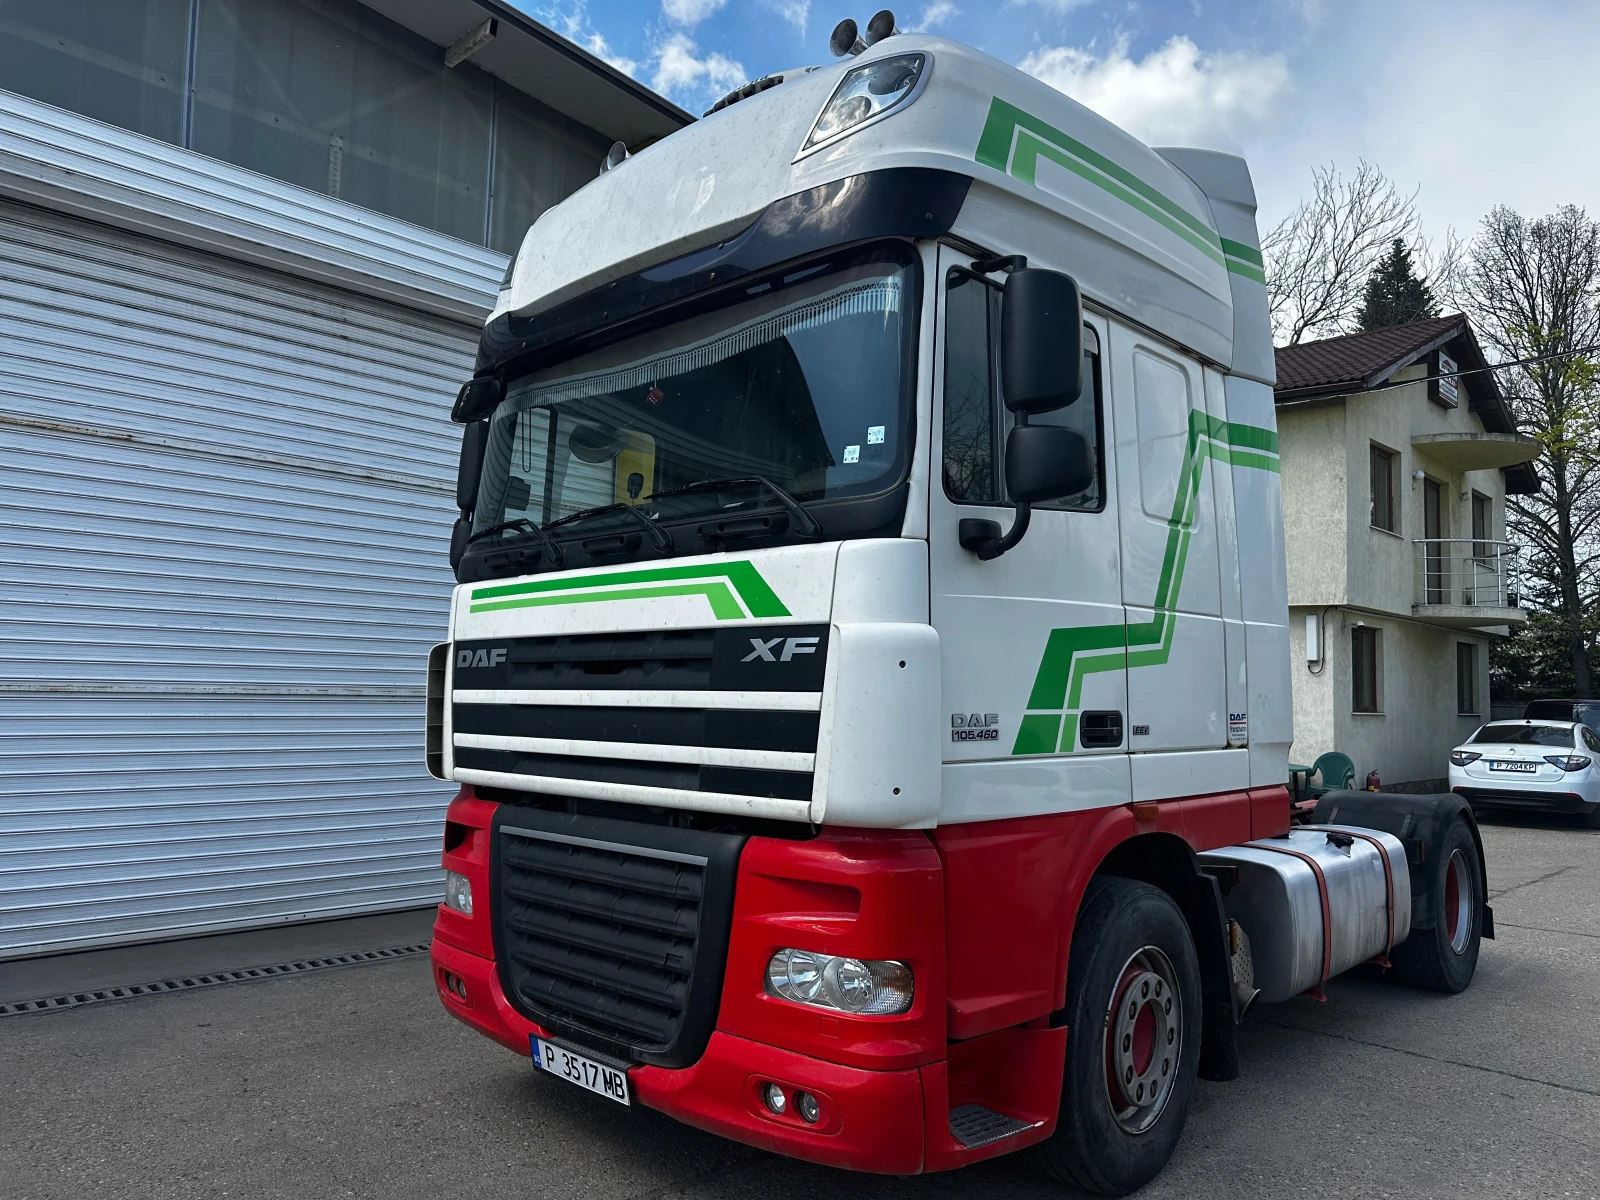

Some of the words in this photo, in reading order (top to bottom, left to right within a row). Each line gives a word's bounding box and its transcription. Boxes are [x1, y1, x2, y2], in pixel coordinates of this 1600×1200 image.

[457, 648, 507, 668] DAF
[740, 637, 820, 662] XF
[951, 713, 999, 728] DAF
[1229, 713, 1247, 722] DAF
[954, 729, 998, 740] 105.460
[545, 1044, 554, 1068] P
